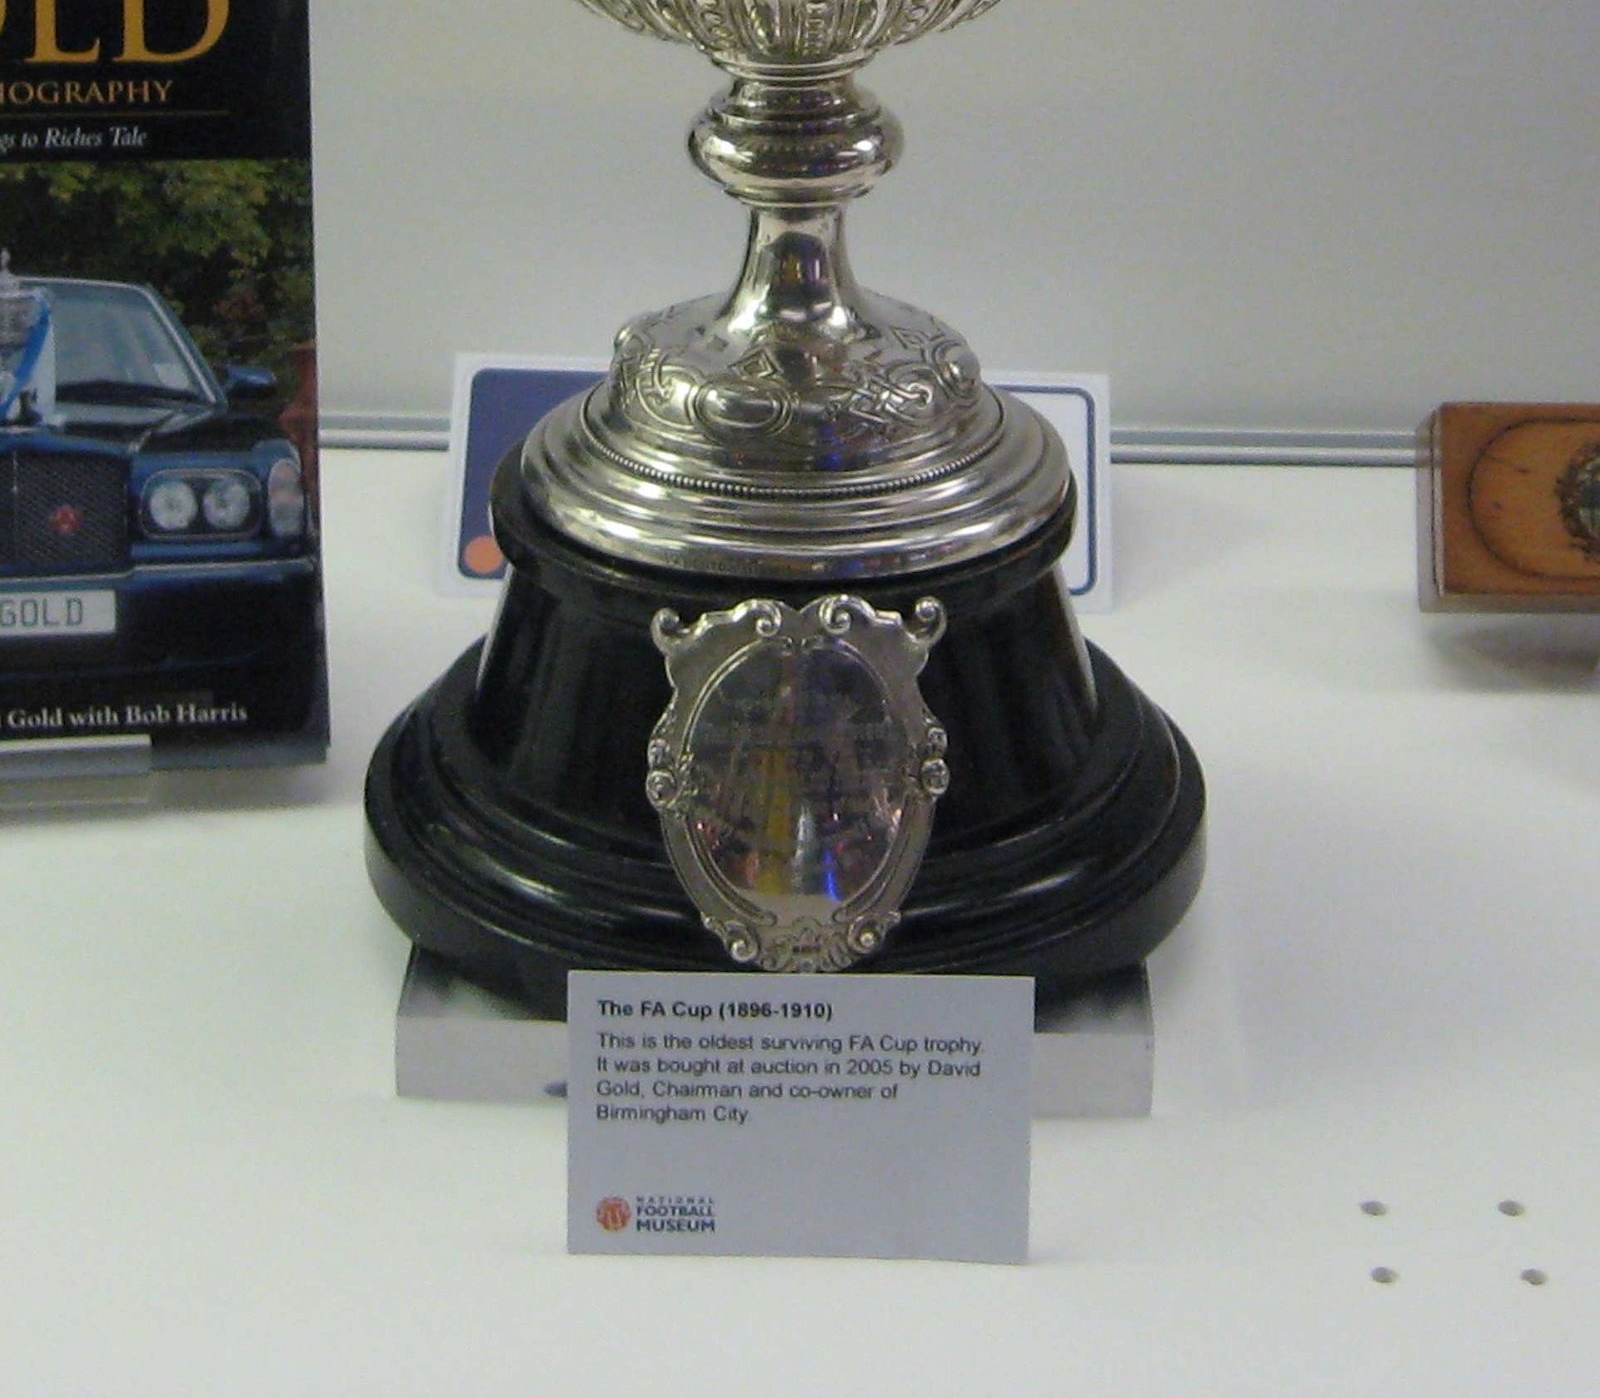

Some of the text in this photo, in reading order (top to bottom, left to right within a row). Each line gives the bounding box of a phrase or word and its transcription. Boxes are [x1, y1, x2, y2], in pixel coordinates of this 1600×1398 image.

[21, 131, 39, 148] to
[45, 125, 102, 148] Riches
[109, 125, 148, 147] Tale
[0, 597, 83, 627] GOLD
[7, 702, 249, 728] Gold with Bob Harris
[599, 1000, 833, 1022] The FA Cup (1896-1910)
[598, 1032, 635, 1049] This
[641, 1033, 657, 1049] is
[663, 1033, 693, 1049] the
[699, 1033, 754, 1050] oldest
[761, 1034, 843, 1054] surviving
[849, 1034, 875, 1052] FA
[880, 1034, 918, 1054] Cup
[597, 1057, 982, 1079] It was bought at auction in 2005 by David
[652, 1080, 742, 1098] Chairman
[749, 1083, 783, 1098] and
[789, 1084, 874, 1100] co-owner
[881, 1083, 899, 1099] of
[597, 1104, 706, 1123] Birmingham
[636, 1195, 714, 1205] NATIONAL
[637, 1205, 715, 1217] FOOTBALL
[636, 1218, 716, 1233] MUSEUM
